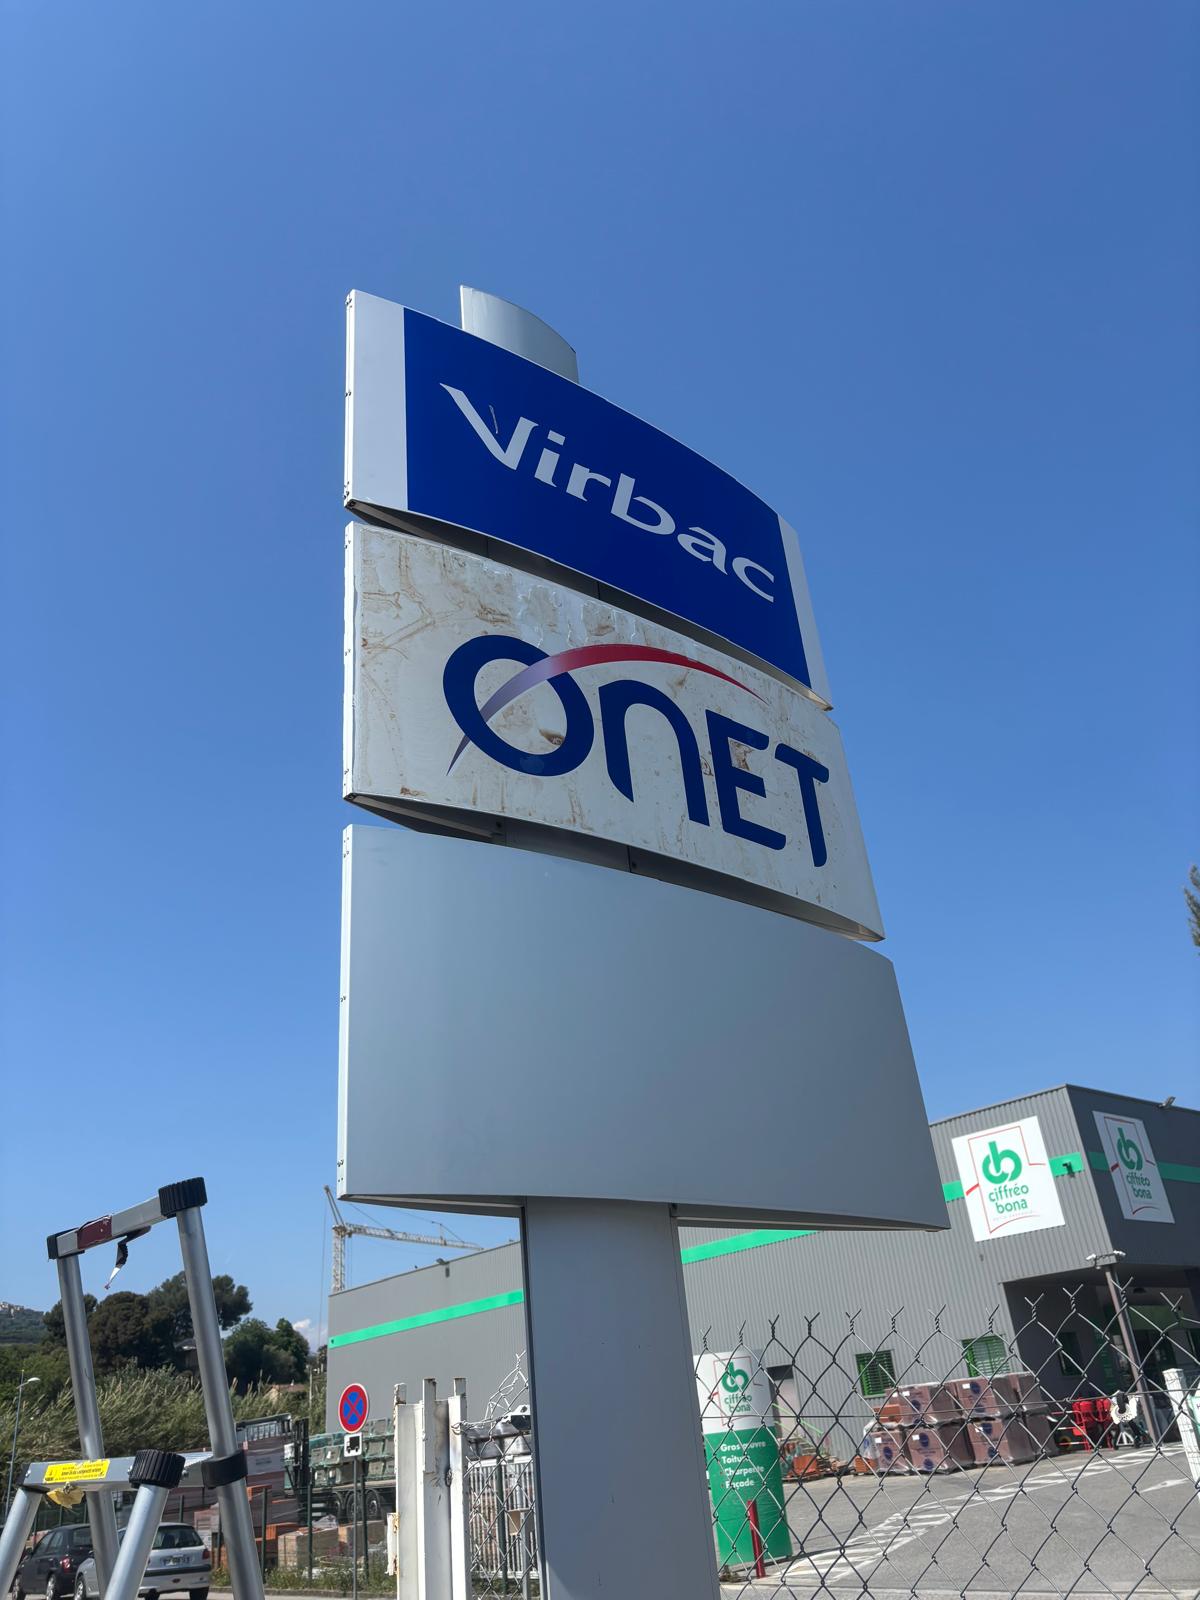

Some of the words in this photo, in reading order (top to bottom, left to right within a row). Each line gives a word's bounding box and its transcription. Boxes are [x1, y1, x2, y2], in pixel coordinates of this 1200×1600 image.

[440, 382, 775, 603] Virbac
[988, 1183, 1029, 1202] ciffréo
[995, 1199, 1028, 1214] bona
[724, 1393, 752, 1404] ciffo
[720, 1443, 741, 1452] Gros
